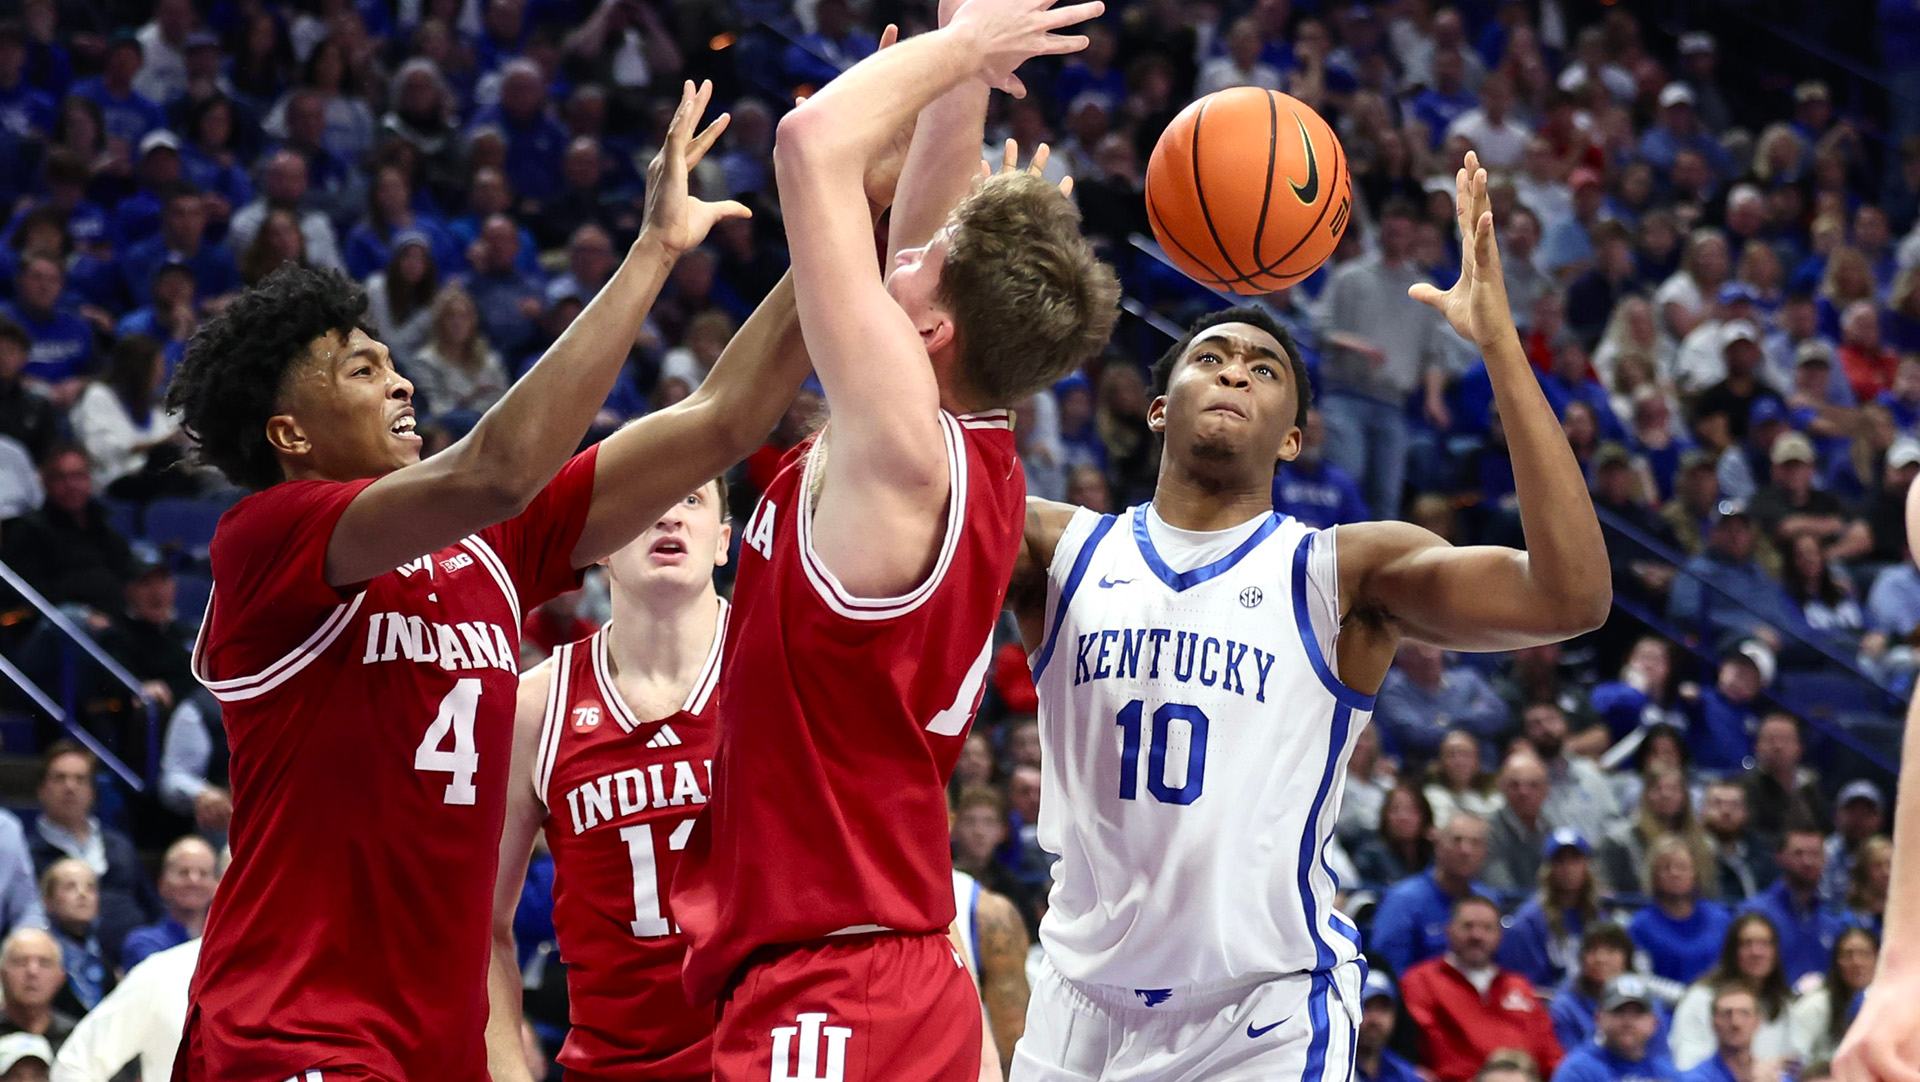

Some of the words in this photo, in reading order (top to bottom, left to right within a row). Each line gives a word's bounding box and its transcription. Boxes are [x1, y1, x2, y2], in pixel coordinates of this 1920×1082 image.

[1240, 586, 1263, 608] SEC
[1074, 628, 1275, 703] KENTUCKY
[414, 678, 482, 805] 4
[1116, 699, 1209, 805] 10
